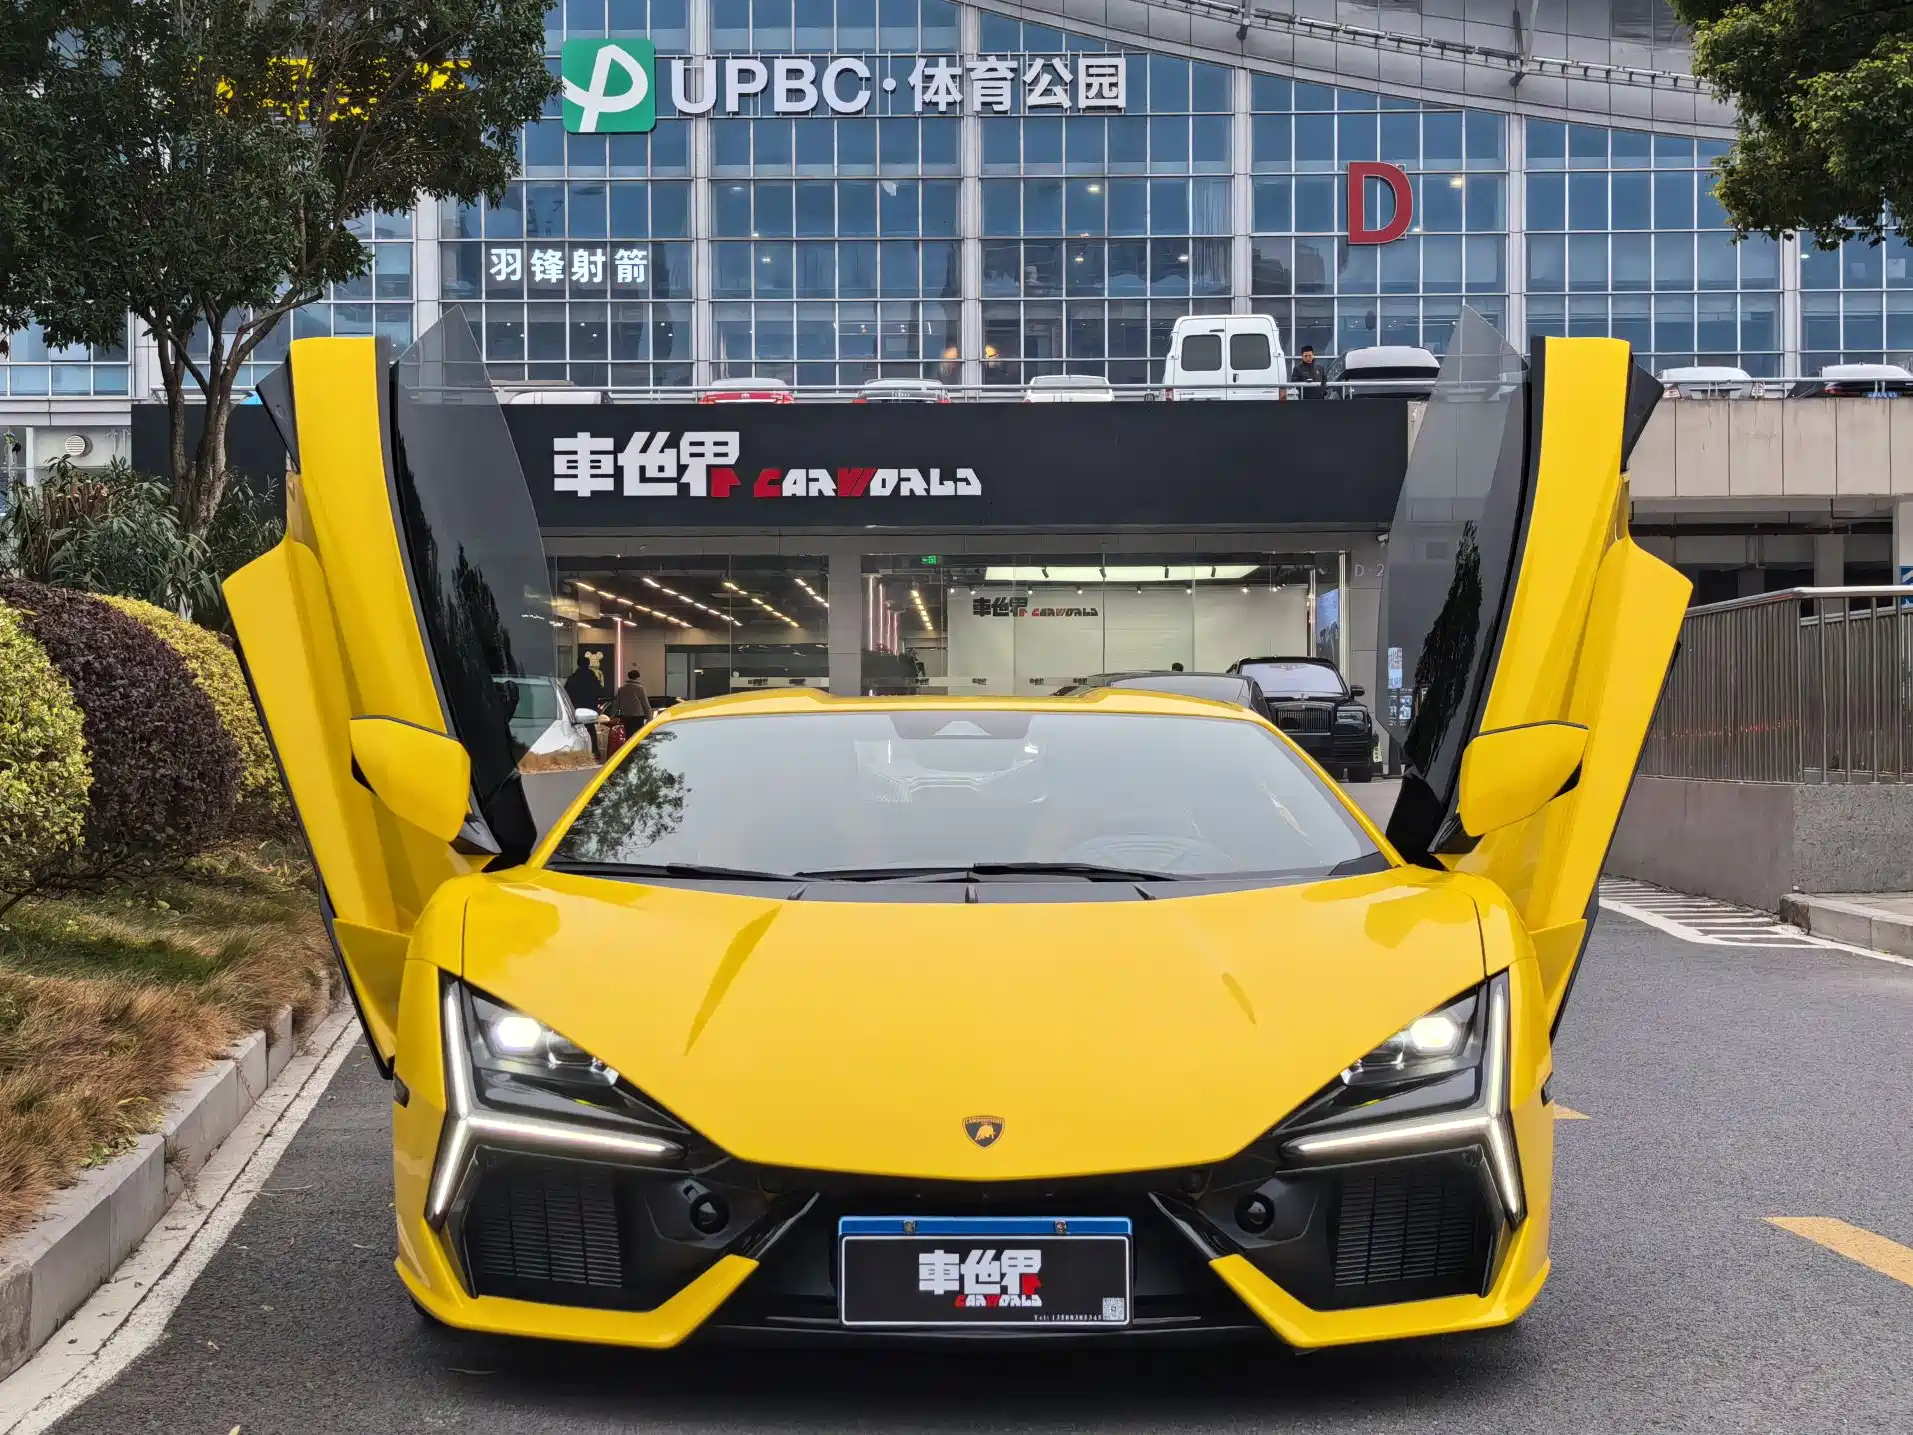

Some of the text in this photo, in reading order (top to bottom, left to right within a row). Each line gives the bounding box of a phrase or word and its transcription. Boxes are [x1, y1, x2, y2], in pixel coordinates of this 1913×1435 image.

[1347, 161, 1413, 244] D
[489, 248, 648, 283] 羽锋射箭
[553, 431, 741, 498] 車世界
[919, 1249, 1042, 1295] 車世界
